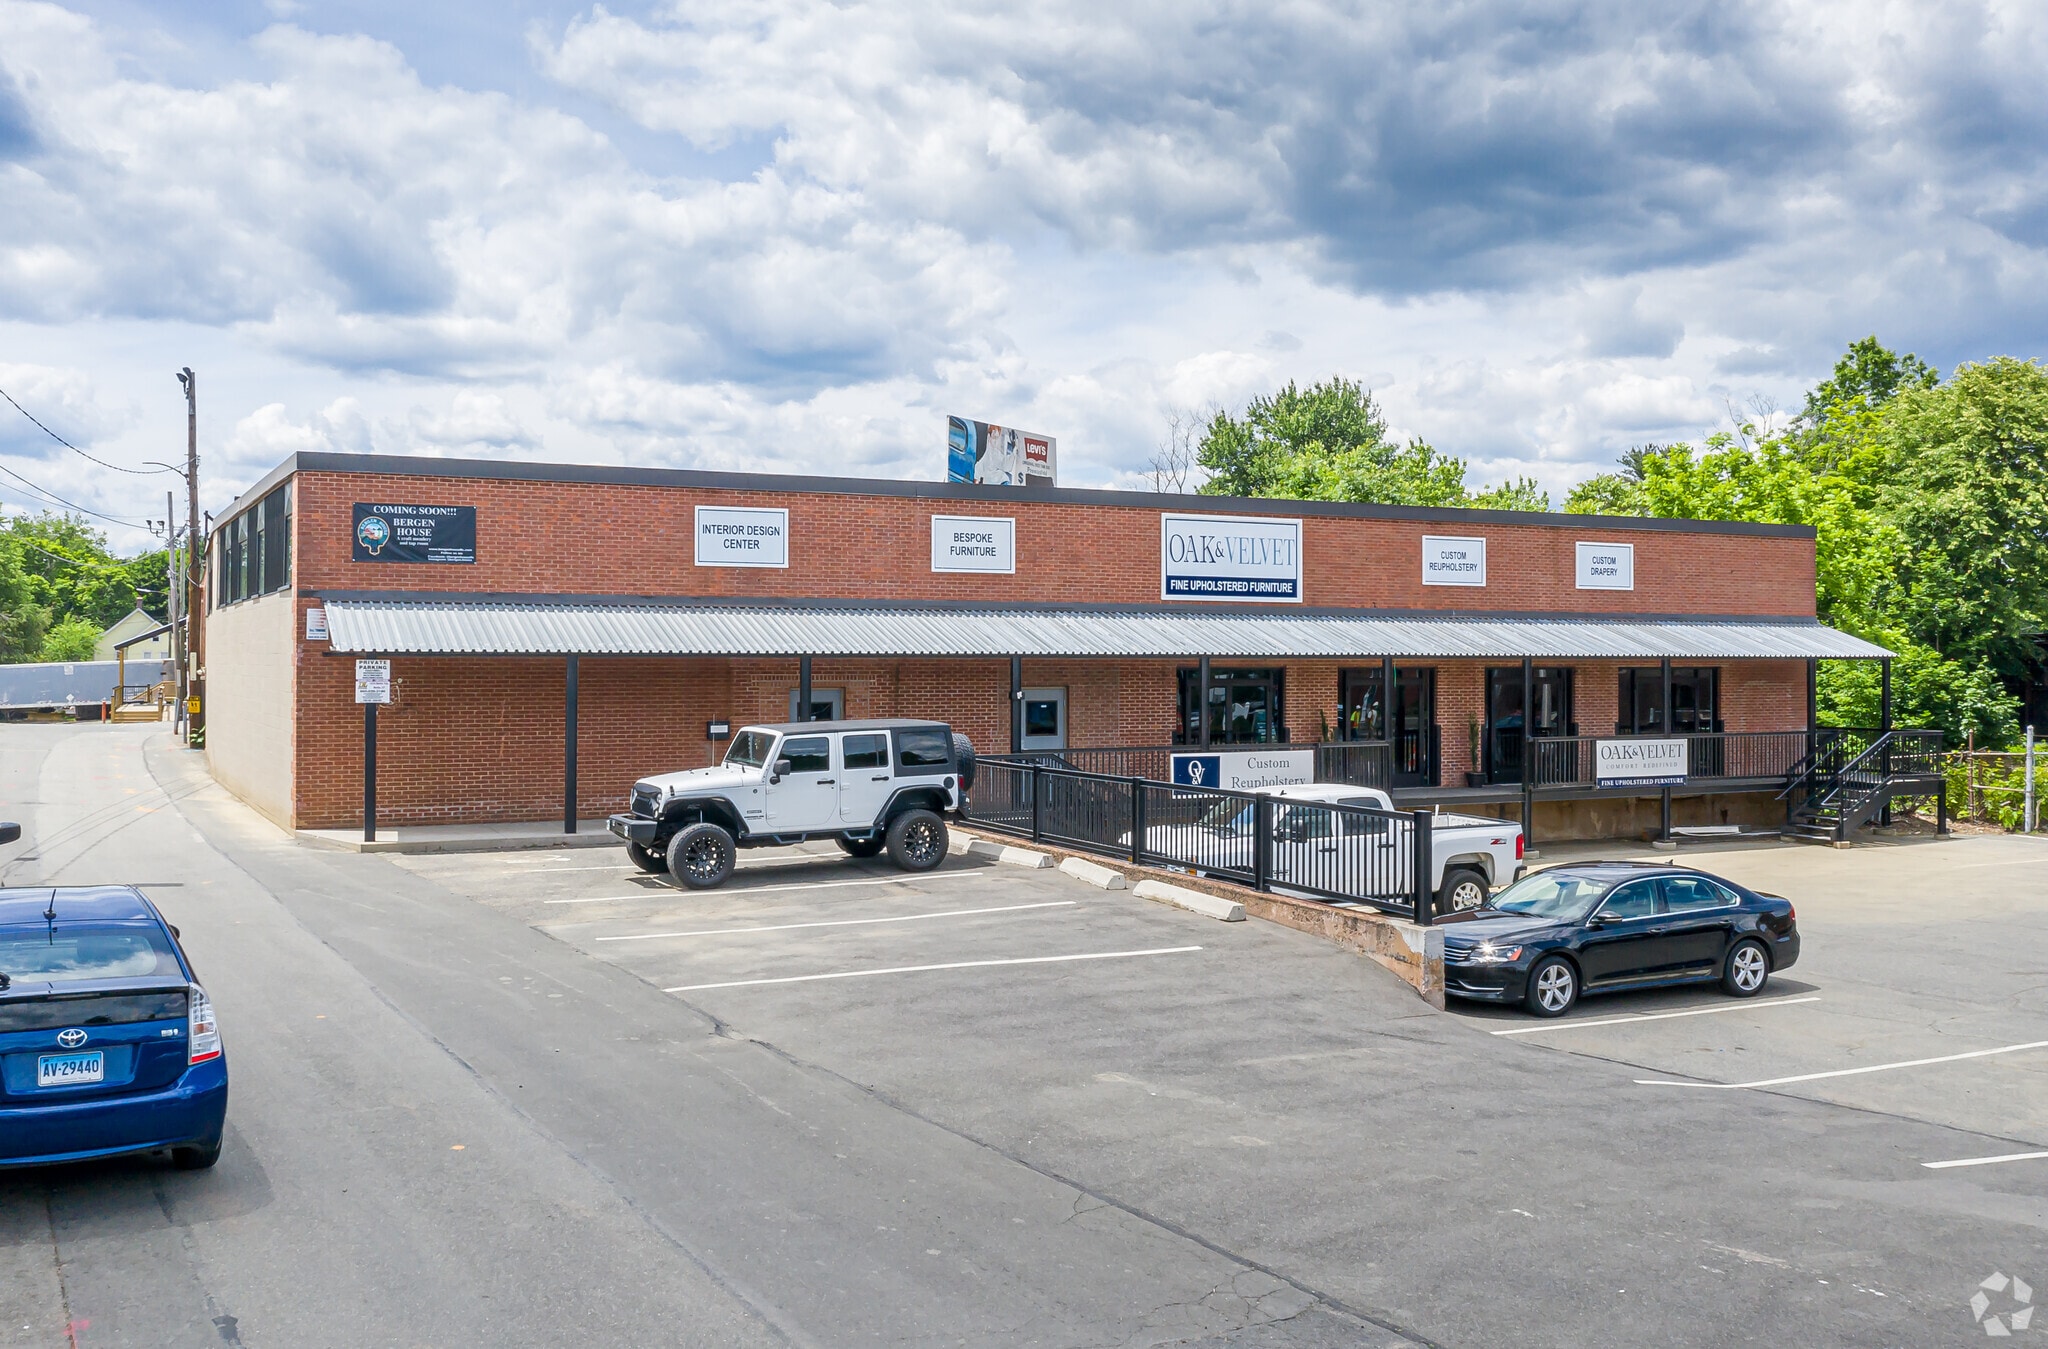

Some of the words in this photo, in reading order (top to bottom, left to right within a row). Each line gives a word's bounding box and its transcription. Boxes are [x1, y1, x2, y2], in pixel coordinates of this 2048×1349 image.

[373, 505, 417, 515] COMING
[418, 506, 457, 516] SOON!!!
[393, 518, 436, 527] BERGEN
[396, 528, 432, 537] HOUSE
[702, 524, 745, 535] INTERIOR
[746, 525, 780, 536] DESIGN
[953, 532, 993, 543] BESPOKE
[723, 538, 760, 549] CENTER
[950, 545, 997, 556] FURNITURE
[1440, 551, 1467, 560] CUSTOM
[1591, 556, 1617, 565] CUSTOM
[1428, 562, 1478, 572] REUPHOLSTERY
[1590, 567, 1618, 576] DRAPERY
[1170, 579, 1190, 591] FINE
[1190, 580, 1249, 592] UPHOLSTERED
[1249, 581, 1293, 593] FURNITURE
[1247, 757, 1290, 769] Custom
[1231, 775, 1306, 788] Reupholstery
[1654, 777, 1684, 786] FURNITURE
